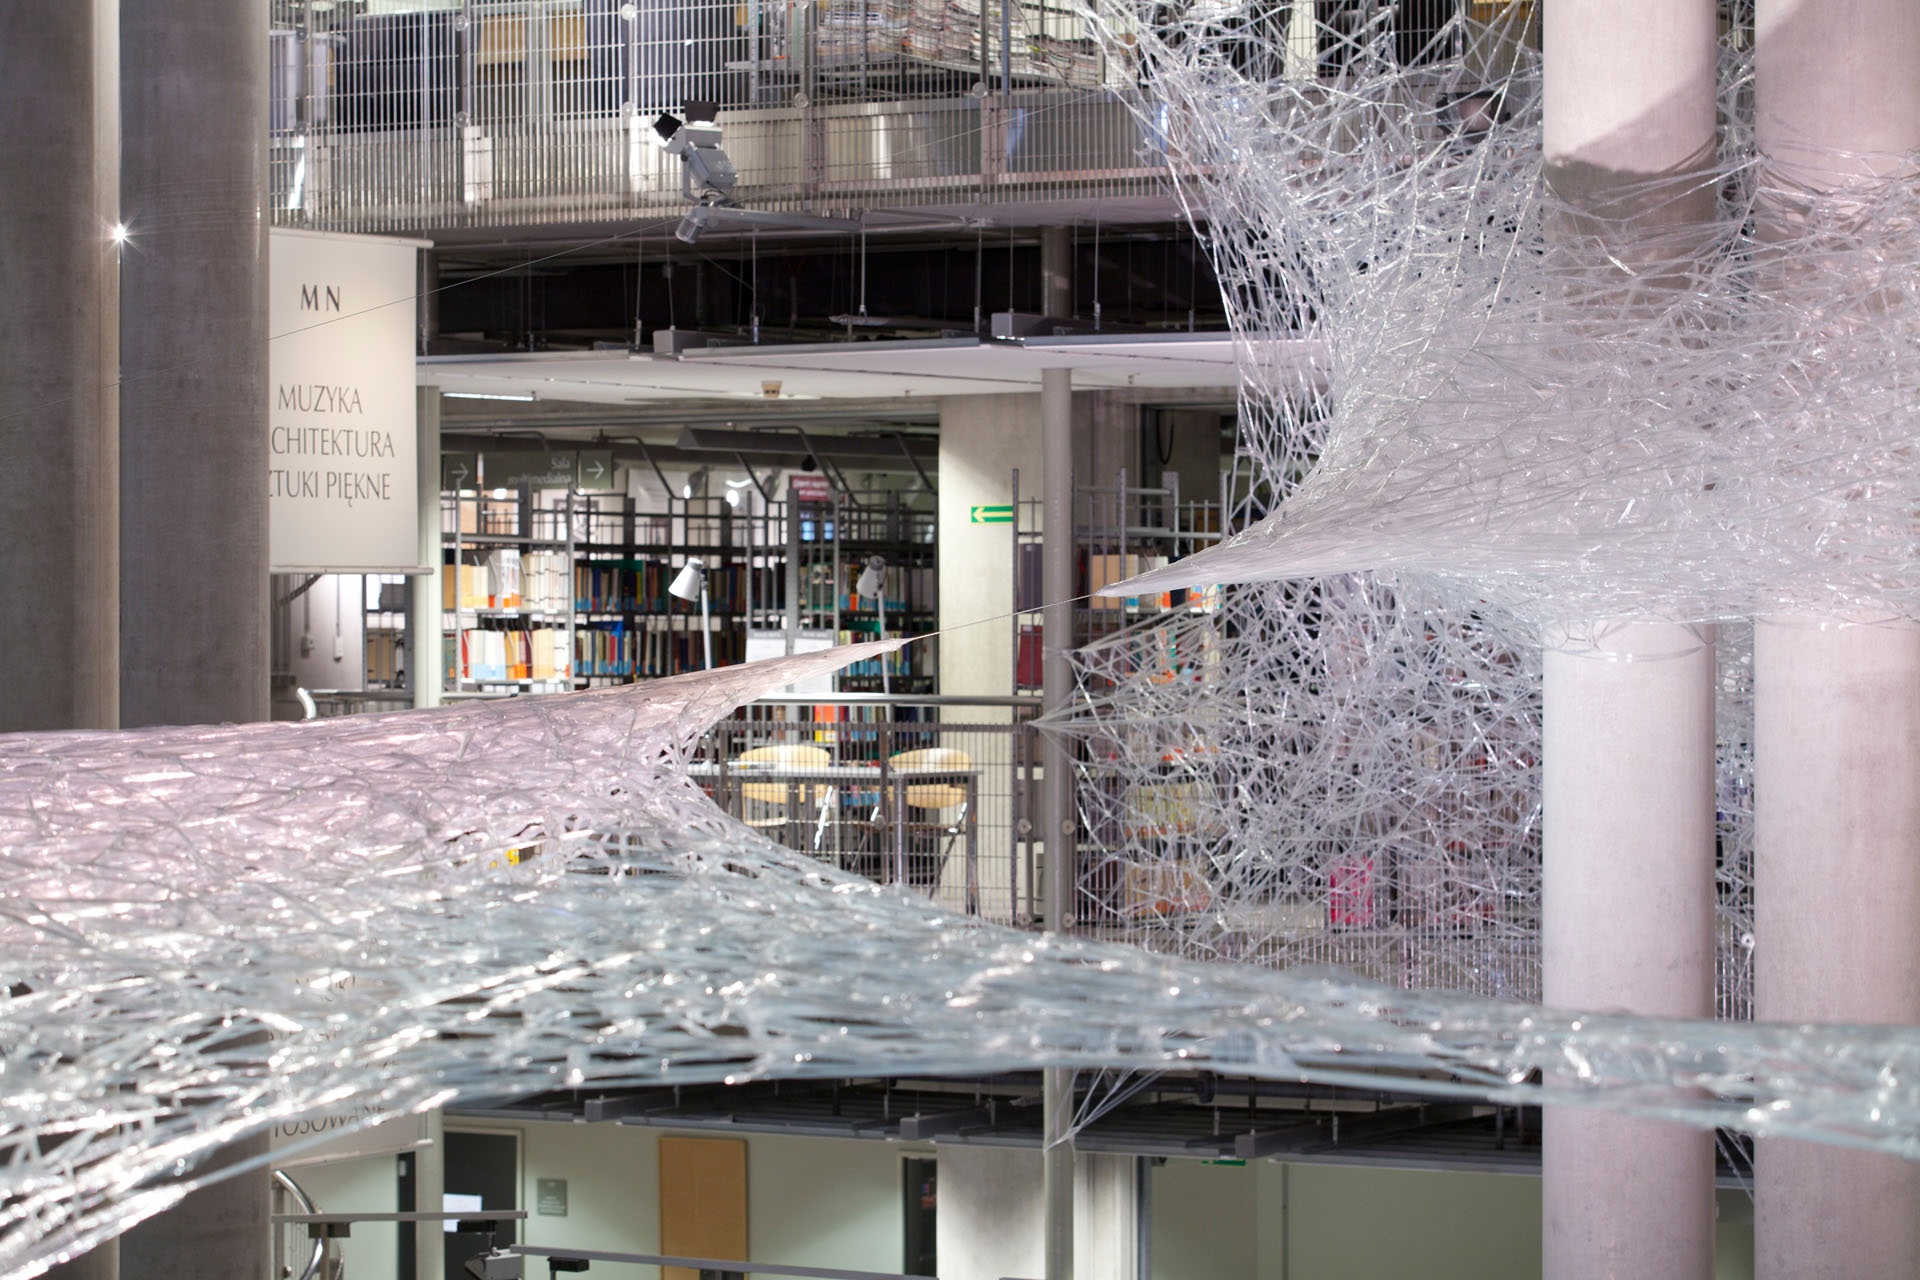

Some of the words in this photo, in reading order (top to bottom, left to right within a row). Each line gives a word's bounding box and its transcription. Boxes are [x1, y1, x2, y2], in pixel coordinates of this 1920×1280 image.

[277, 383, 363, 415] MUZYKA
[270, 426, 395, 458] CHITEKTURA
[326, 471, 392, 508] PIĘKNE
